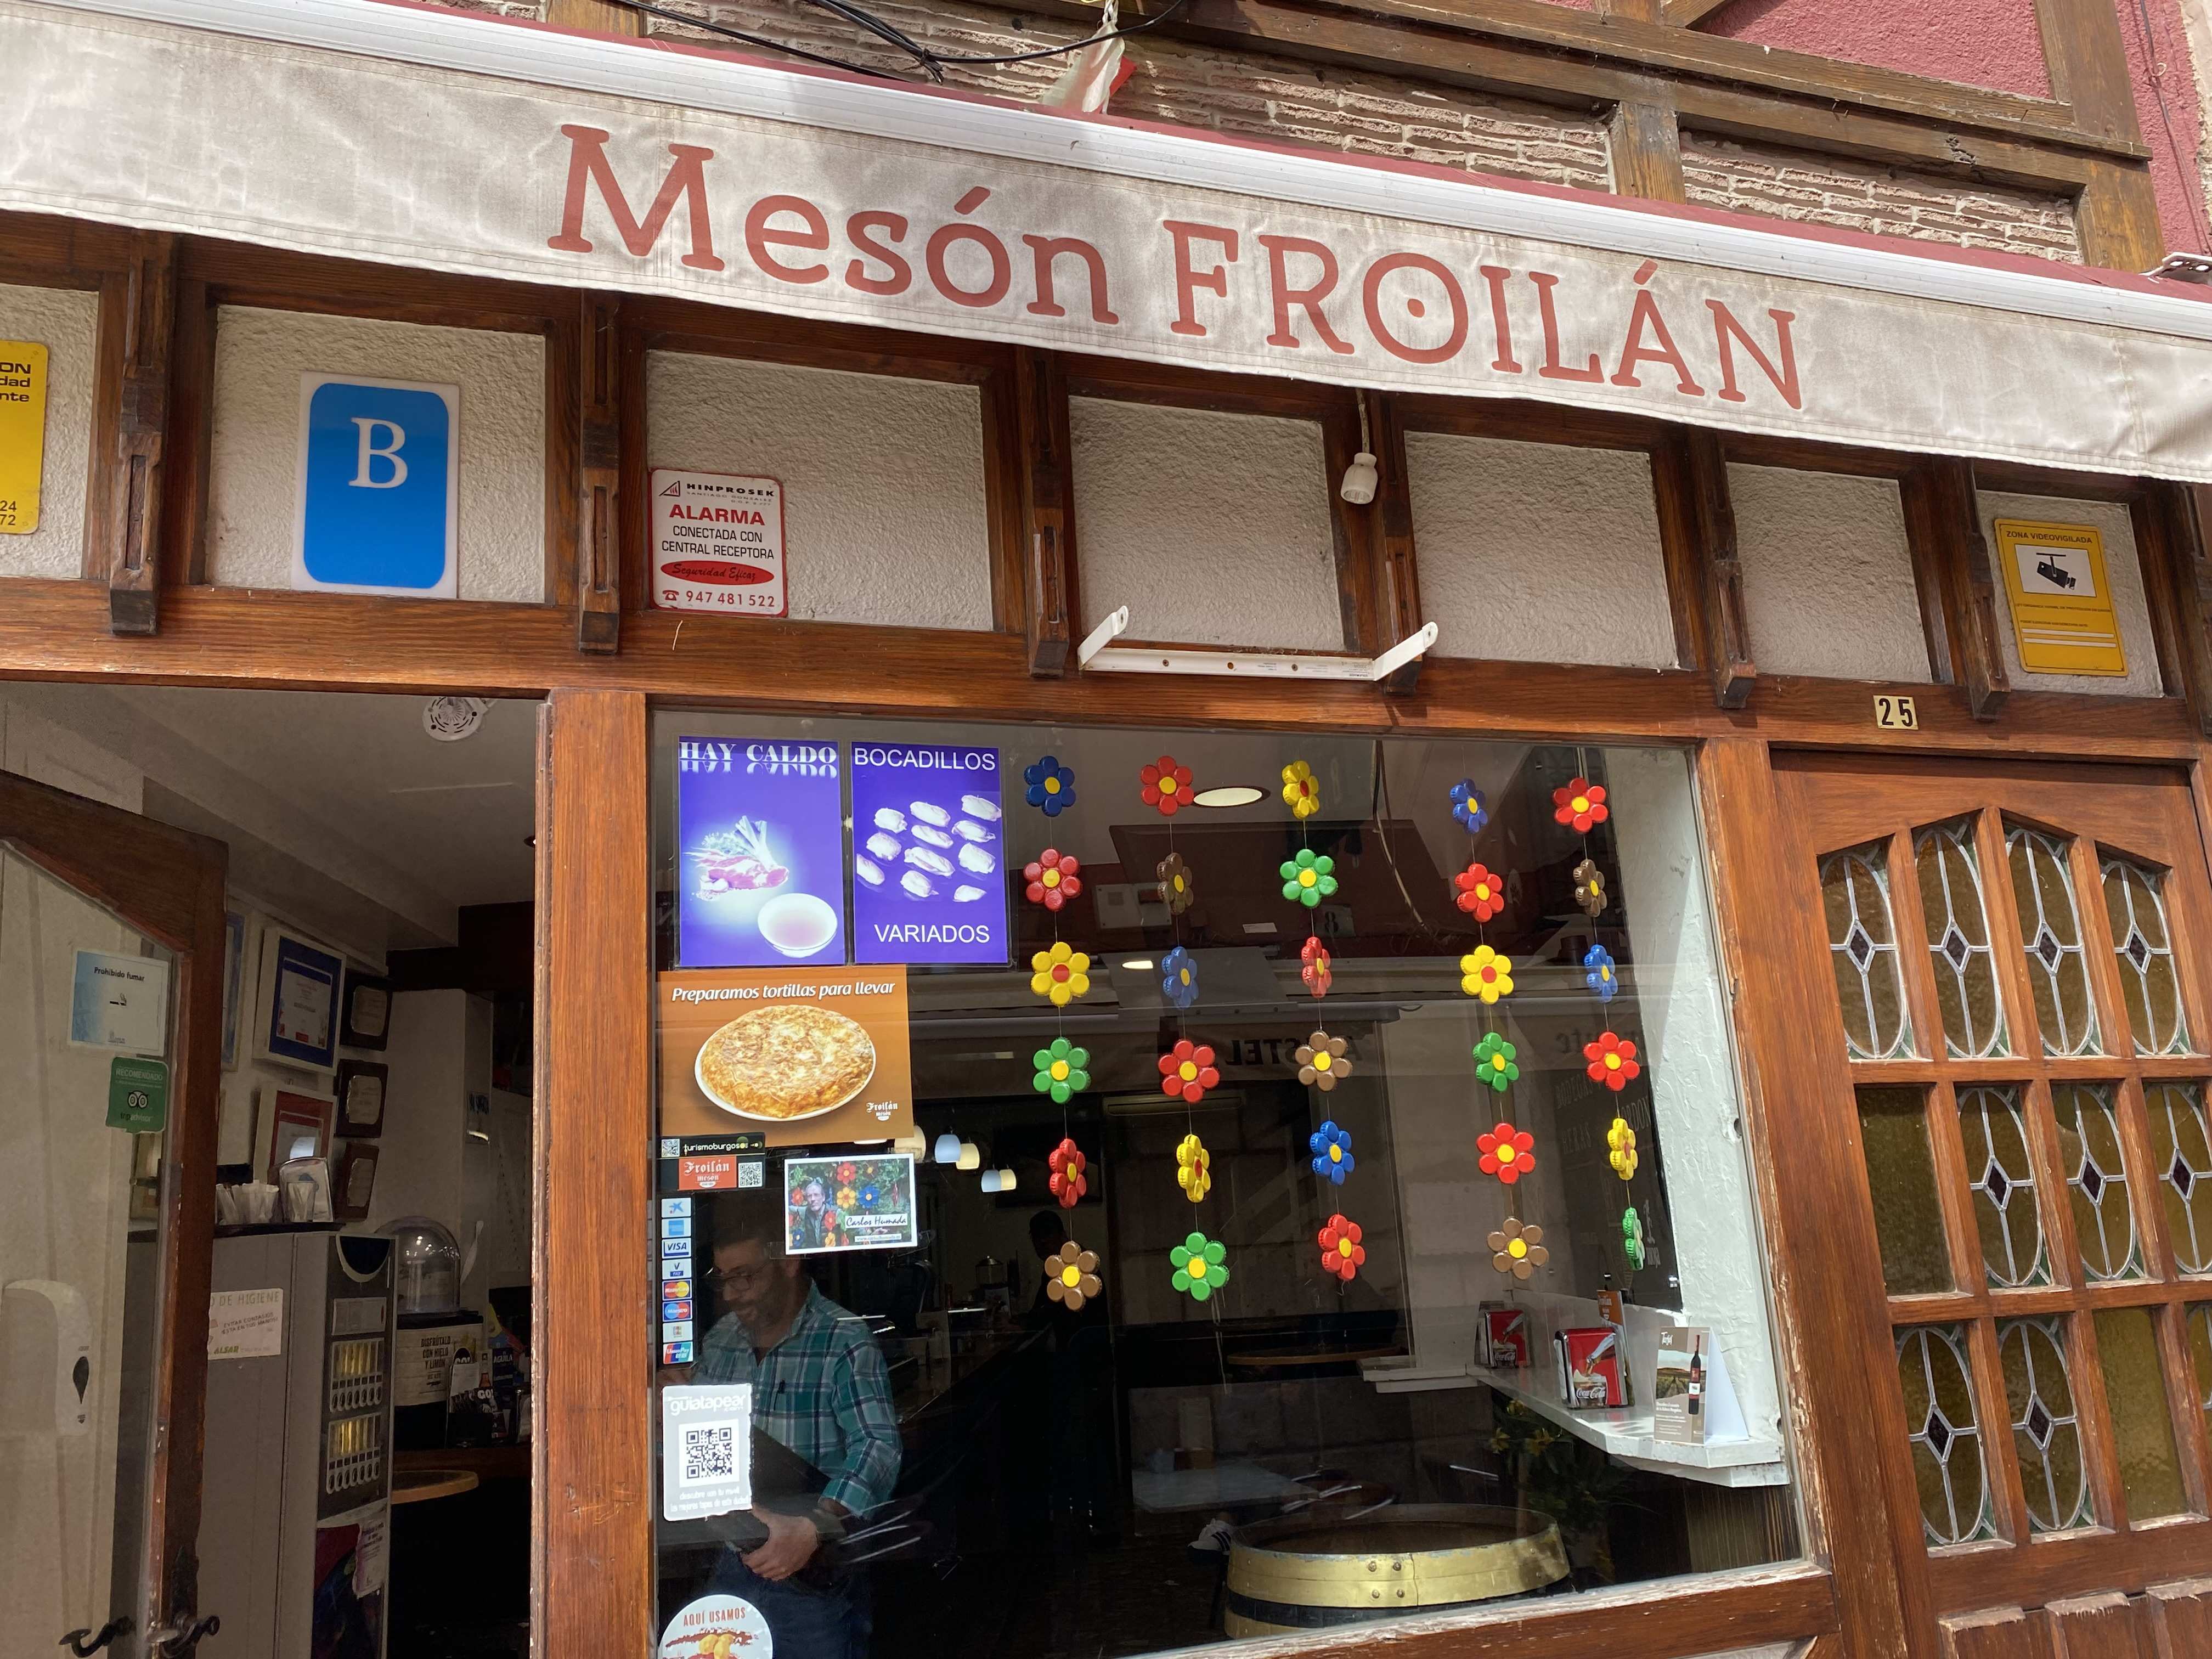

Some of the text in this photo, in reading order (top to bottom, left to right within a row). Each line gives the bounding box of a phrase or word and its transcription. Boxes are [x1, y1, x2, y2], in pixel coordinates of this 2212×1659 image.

[548, 123, 1803, 410] Mesón FROILÁN
[349, 417, 408, 489] B
[686, 483, 775, 496] HINPROSEK
[669, 504, 765, 526] ALARMA
[673, 525, 763, 543] CONECTADA CON
[2006, 531, 2092, 544] ZONA VIDEOVIGILADA
[662, 540, 775, 560] CENTRAL RECEPTORA
[671, 563, 756, 582] Seguridad Eficaz
[686, 590, 775, 607] 947 481 522
[1878, 697, 1914, 727] 25
[679, 741, 837, 764] HAY CALDO
[854, 748, 996, 771] BOCADILLOS
[874, 924, 990, 944] VARIADOS
[94, 967, 145, 981] Prohibido fumar
[672, 981, 895, 1005] Preparamos tortillas para llevar
[116, 1068, 163, 1080] RECOMENDADO
[120, 1113, 154, 1122] tripadvisor
[684, 1159, 730, 1176] Froilán
[846, 1215, 906, 1226] Carlos Humada
[667, 1242, 687, 1251] VISA
[219, 1295, 232, 1306] DE
[238, 1291, 280, 1305] HIGIENE
[1576, 1386, 1606, 1399] Coca-Cola
[684, 1606, 746, 1627] AQUÍ USAMOS
